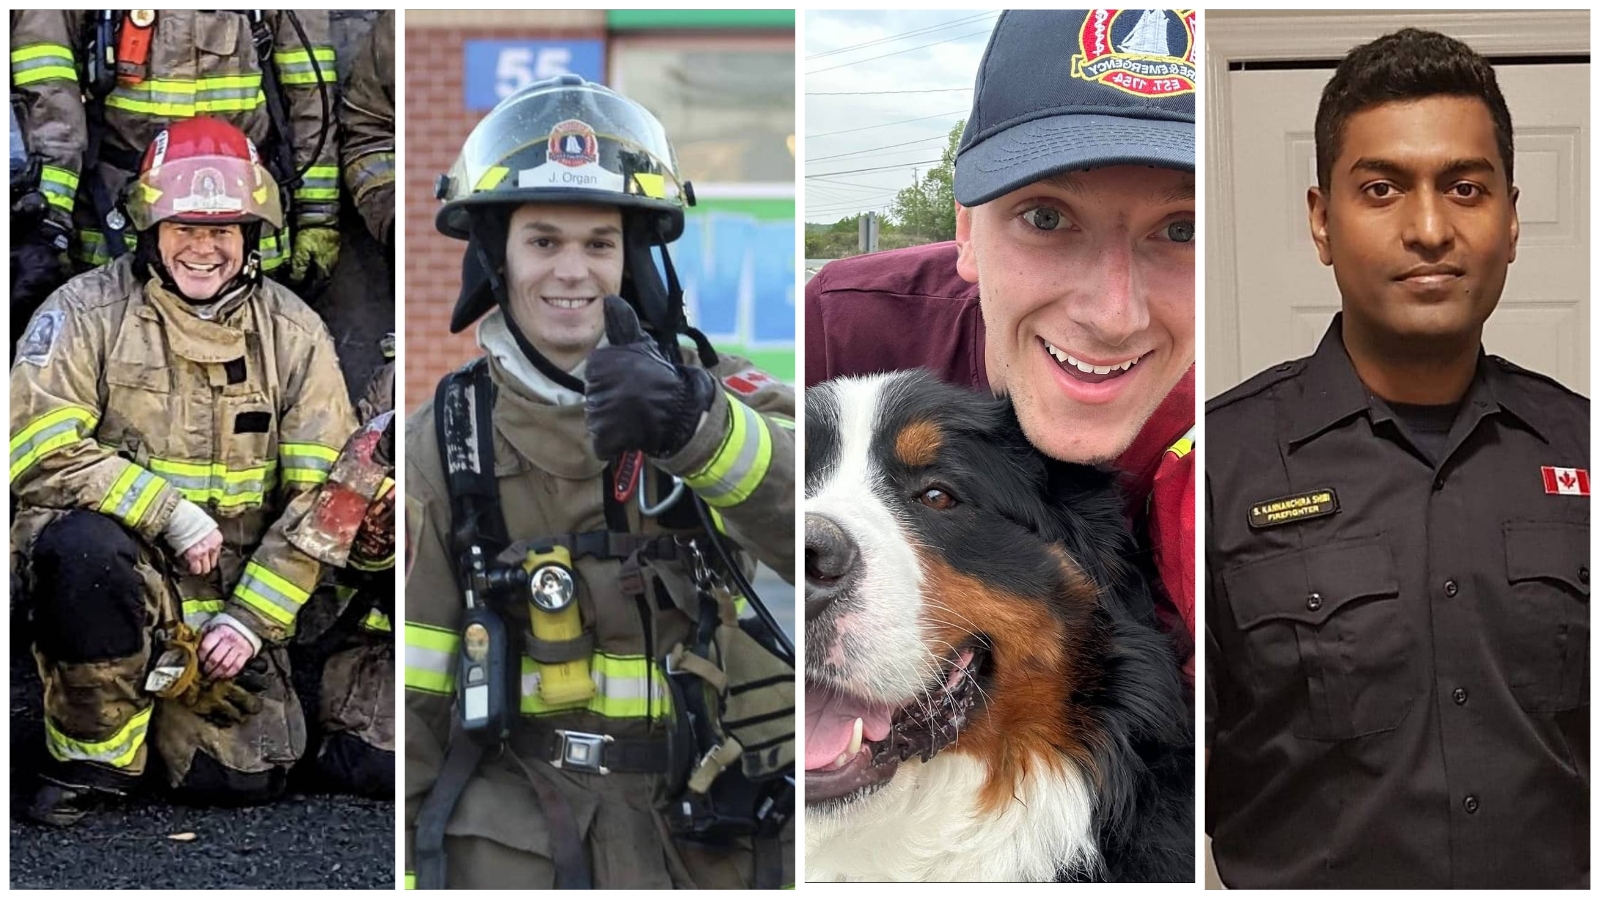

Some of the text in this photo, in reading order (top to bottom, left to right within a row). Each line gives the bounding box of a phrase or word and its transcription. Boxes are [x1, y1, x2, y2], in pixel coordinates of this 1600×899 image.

[548, 172, 598, 185] J. Organ
[1267, 505, 1320, 521] FIREFIGHTER
